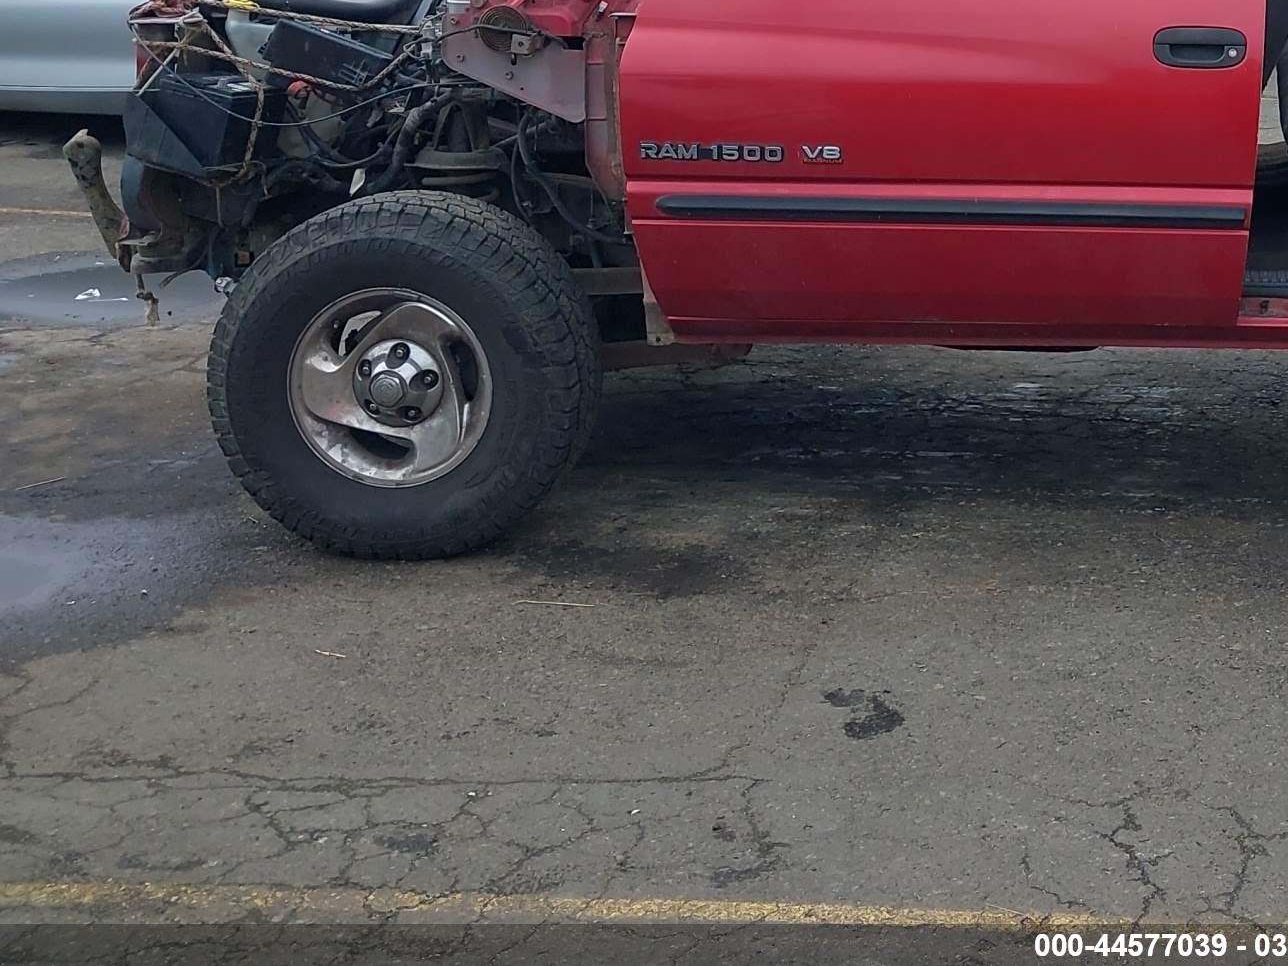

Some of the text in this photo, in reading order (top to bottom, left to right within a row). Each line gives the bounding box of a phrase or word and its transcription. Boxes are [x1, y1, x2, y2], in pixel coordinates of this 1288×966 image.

[640, 142, 783, 162] RAM 1500
[801, 145, 841, 159] V8
